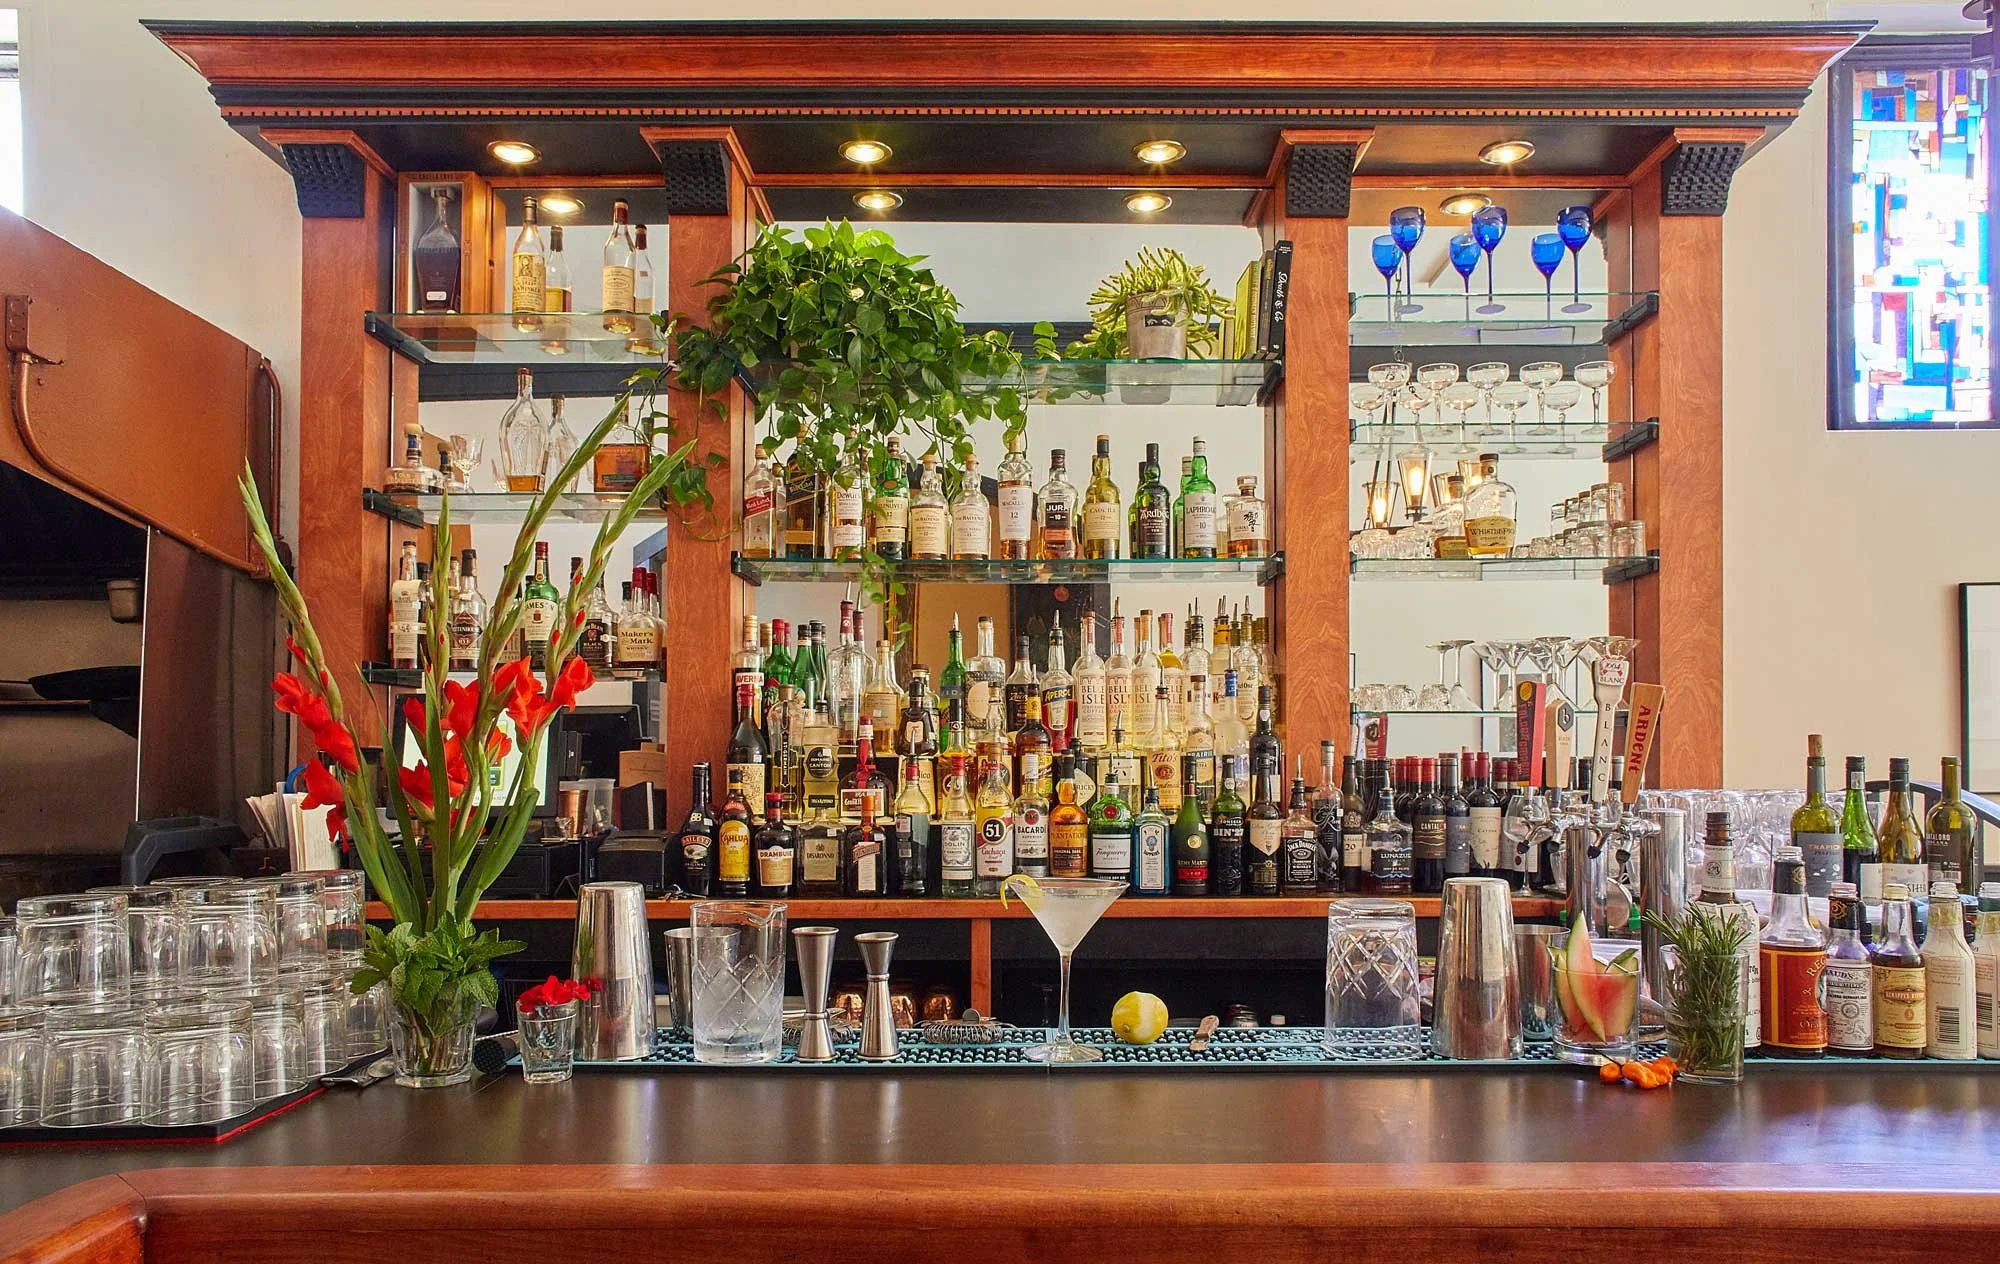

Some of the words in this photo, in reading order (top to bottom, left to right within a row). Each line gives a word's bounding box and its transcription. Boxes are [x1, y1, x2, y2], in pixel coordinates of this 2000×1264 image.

[1600, 676, 1625, 684] BLANC
[1081, 685, 1105, 693] BELLE
[1045, 688, 1071, 702] APEROL
[1081, 694, 1105, 705] ISLE
[1597, 703, 1612, 782] BLANC
[1152, 752, 1177, 763] Tito's
[985, 823, 1001, 837] 51
[1287, 842, 1298, 852] JACK
[1345, 843, 1356, 851] 20
[759, 850, 793, 858] DRAMBUIE
[1096, 848, 1128, 857] Tanqueray
